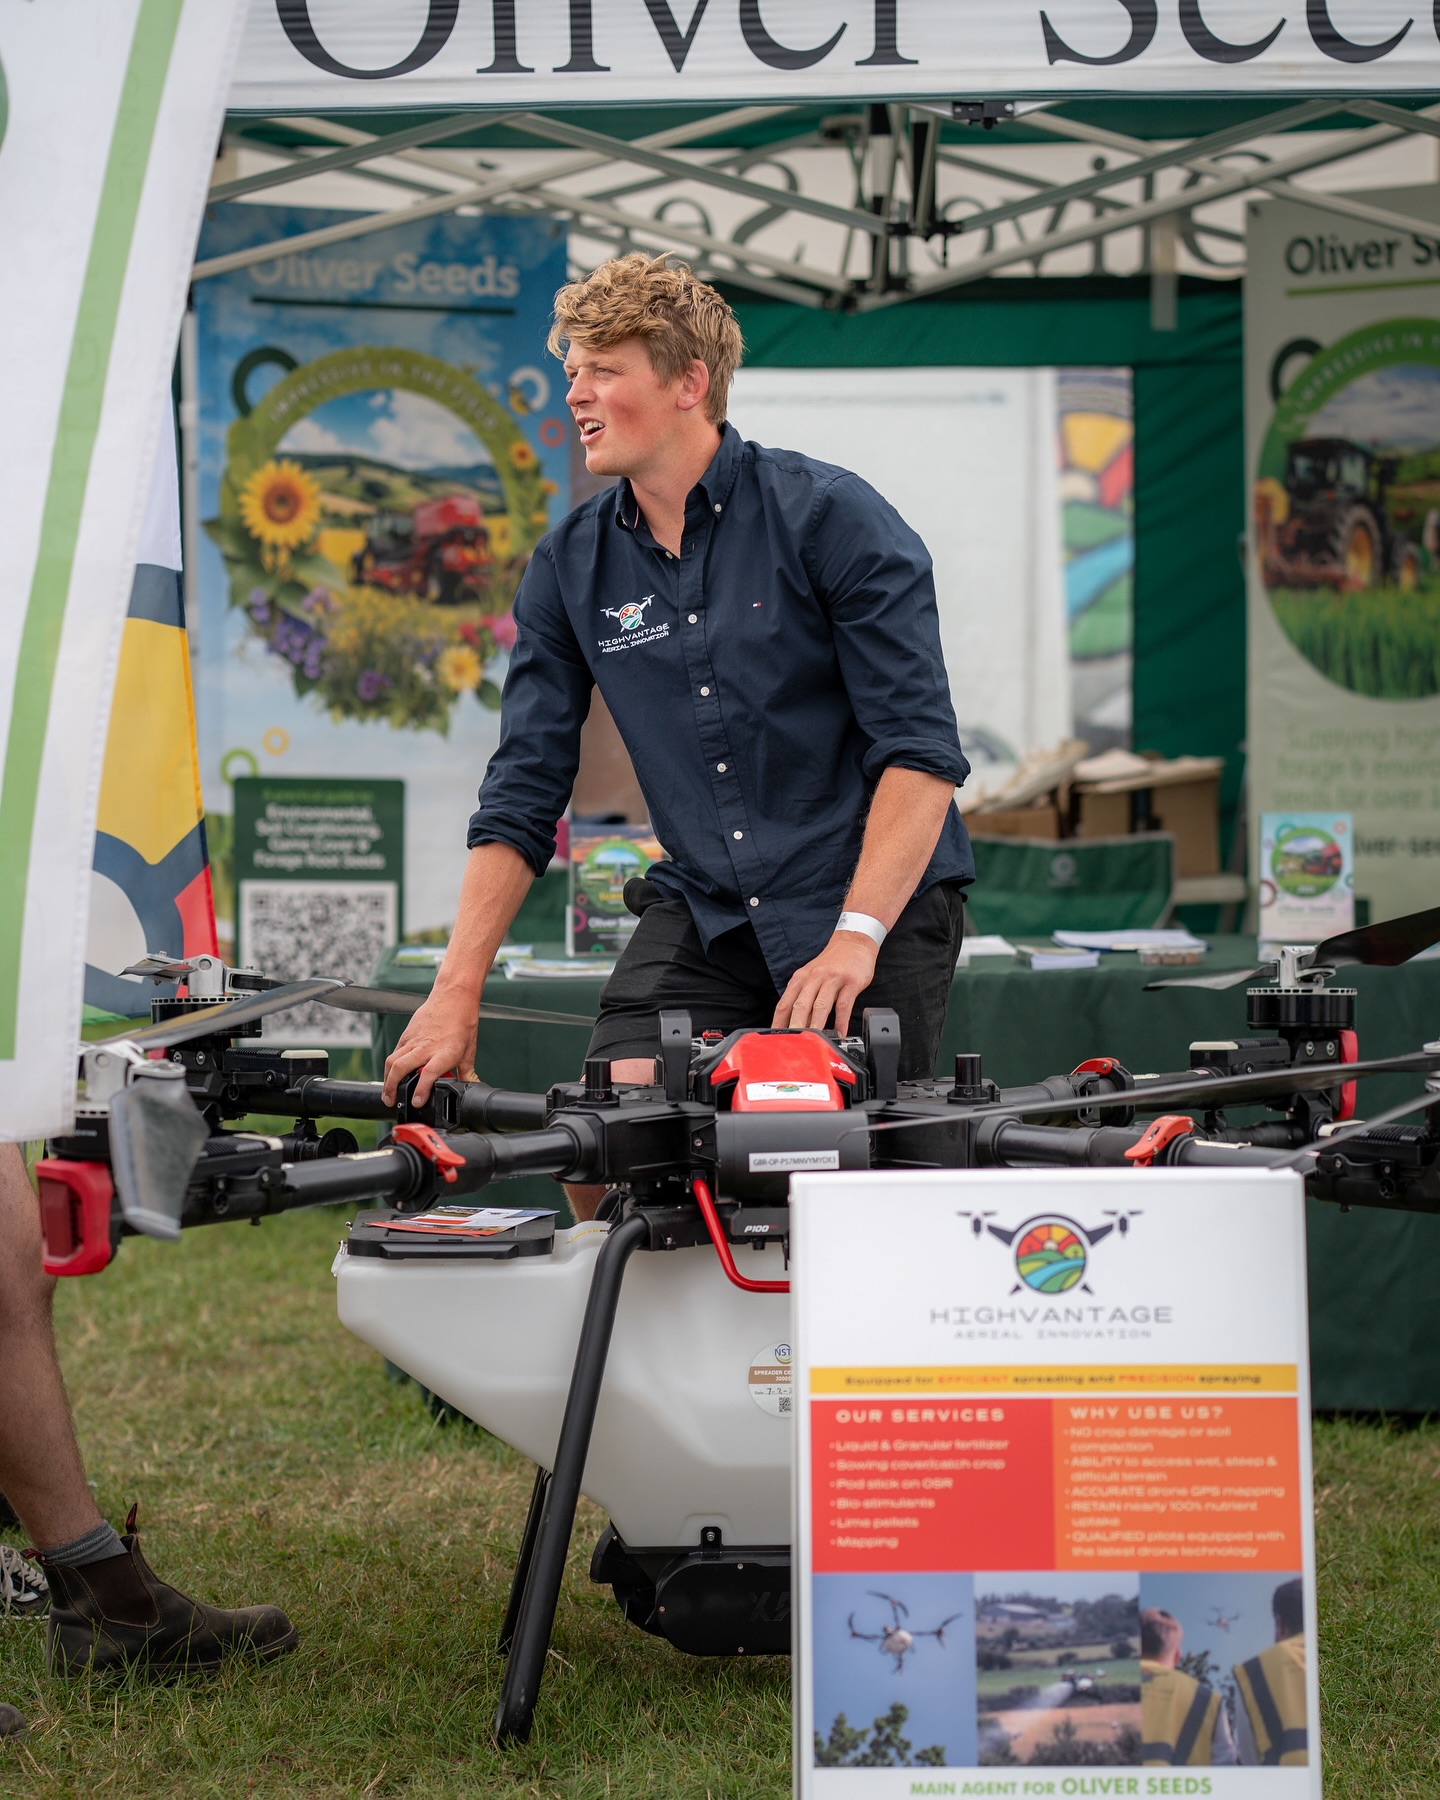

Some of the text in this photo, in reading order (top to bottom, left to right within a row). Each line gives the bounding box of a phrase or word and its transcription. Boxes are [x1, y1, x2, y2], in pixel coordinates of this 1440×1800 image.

[1284, 233, 1440, 276] Oliver S
[250, 252, 520, 298] Oliver Seeds
[597, 622, 670, 647] HIGHVANTAGE
[601, 643, 630, 653] AERIAL
[743, 1224, 770, 1234] P100
[930, 1305, 1174, 1325] HIGHVANTAGE
[953, 1328, 1153, 1340] AERIAL INNOVATION
[845, 1373, 1261, 1386] Equipped for EFFICIENT spreading and PRECISION spraying
[835, 1407, 1006, 1425] OUR SERVICES
[1070, 1405, 1224, 1421] WHY USE US?
[1070, 1426, 1231, 1439] NO crop damage or soil
[835, 1437, 1010, 1452] Liquid & Granular fertilizer
[1070, 1441, 1154, 1453] compaction
[835, 1457, 1006, 1472] Sowing cover/catch crop
[1071, 1456, 1122, 1468] ABILITY
[1125, 1456, 1140, 1467] to
[1141, 1457, 1193, 1467] access
[1225, 1456, 1265, 1468] steep
[1266, 1456, 1277, 1467] &
[836, 1477, 953, 1490] Pod stick on OSR
[1070, 1471, 1168, 1483] difficult terrain
[1071, 1485, 1285, 1498] ACCURATE drone GPS mapping
[1071, 1500, 1122, 1512] RETAIN
[1123, 1501, 1168, 1513] nearly
[1204, 1500, 1257, 1511] nutrient
[836, 1516, 920, 1529] Lime pellets
[1071, 1515, 1121, 1528] uptake
[836, 1536, 899, 1549] Mapping
[1071, 1530, 1285, 1543] QUALIFIED pilots equipped with
[1071, 1545, 1259, 1558] the latest drone technology
[909, 1777, 1213, 1796] MAIN AGENT FOR OLIVER SEEDS
